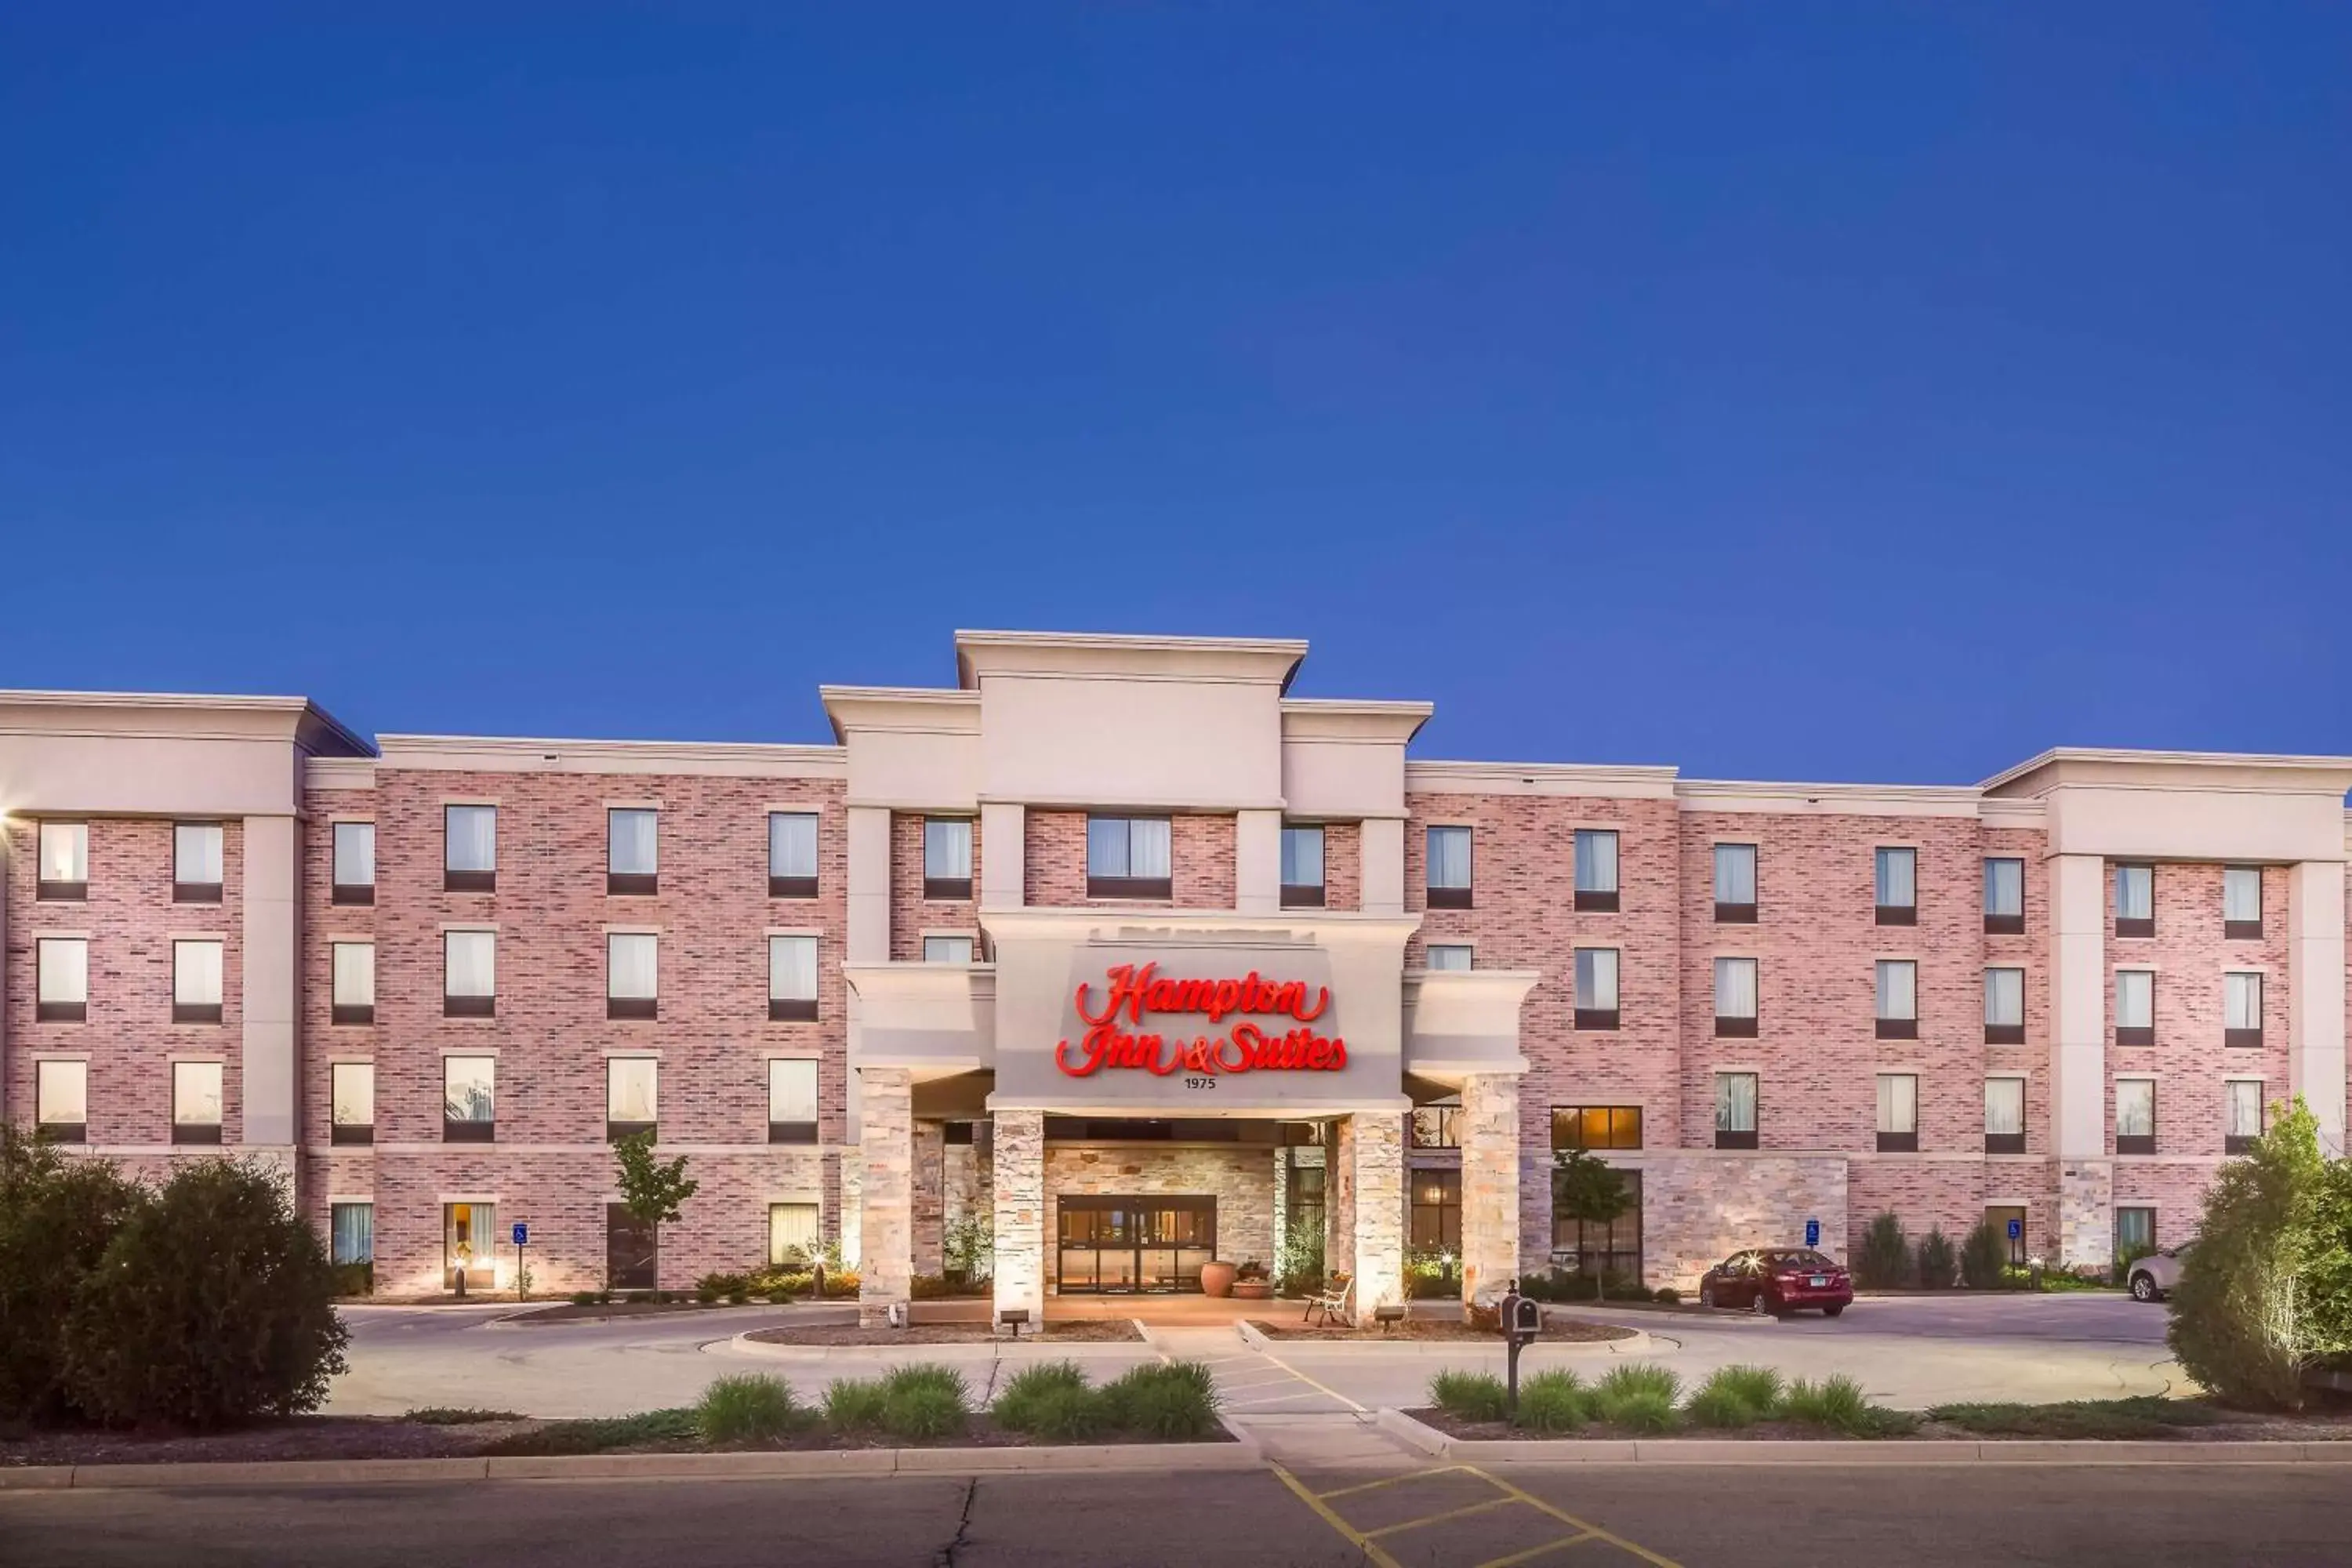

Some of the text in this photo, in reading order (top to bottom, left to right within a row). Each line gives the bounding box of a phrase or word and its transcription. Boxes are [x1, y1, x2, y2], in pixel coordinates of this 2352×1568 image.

[1075, 961, 1329, 1025] Hampton
[1055, 1022, 1348, 1077] Inn & Suites
[1185, 1078, 1215, 1089] 1975
